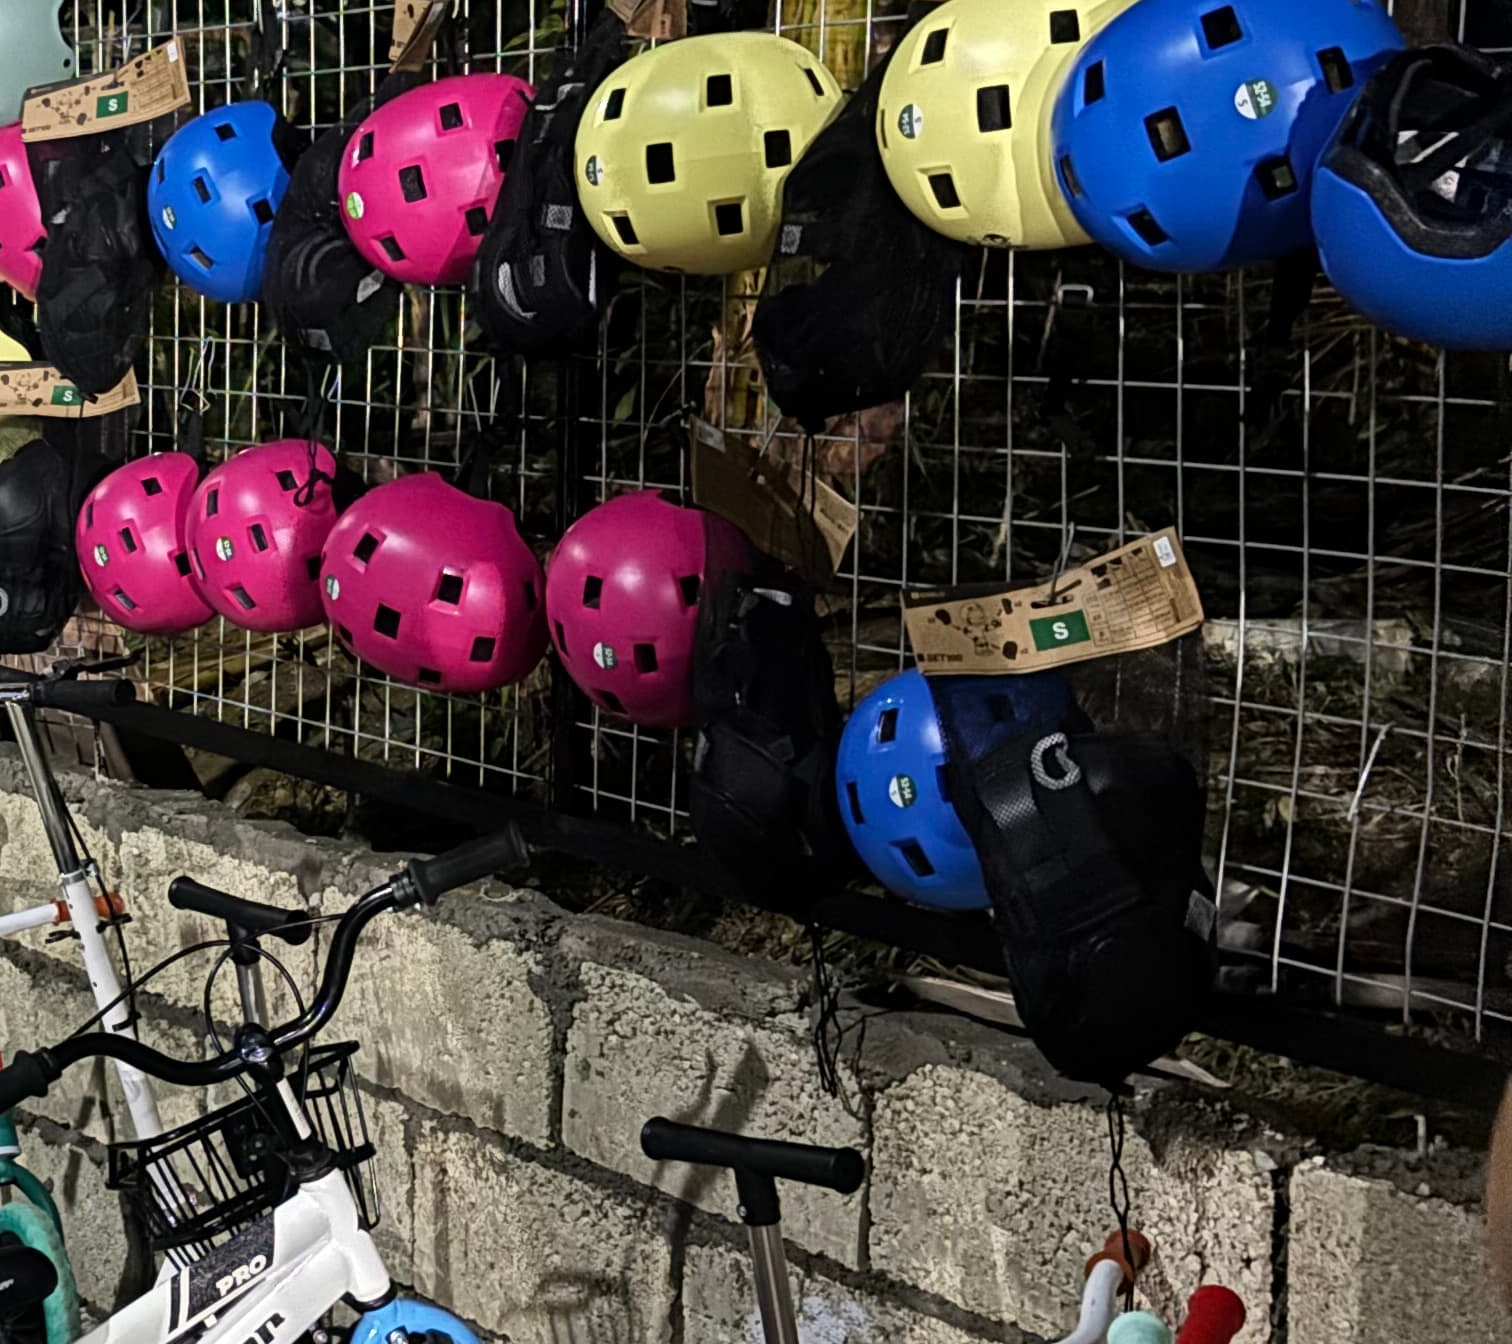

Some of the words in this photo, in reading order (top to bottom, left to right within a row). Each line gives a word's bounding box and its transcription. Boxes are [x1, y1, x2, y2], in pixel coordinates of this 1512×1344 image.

[107, 98, 118, 112] S
[62, 390, 74, 402] S
[1052, 622, 1069, 640] S
[216, 1254, 267, 1297] PRO
